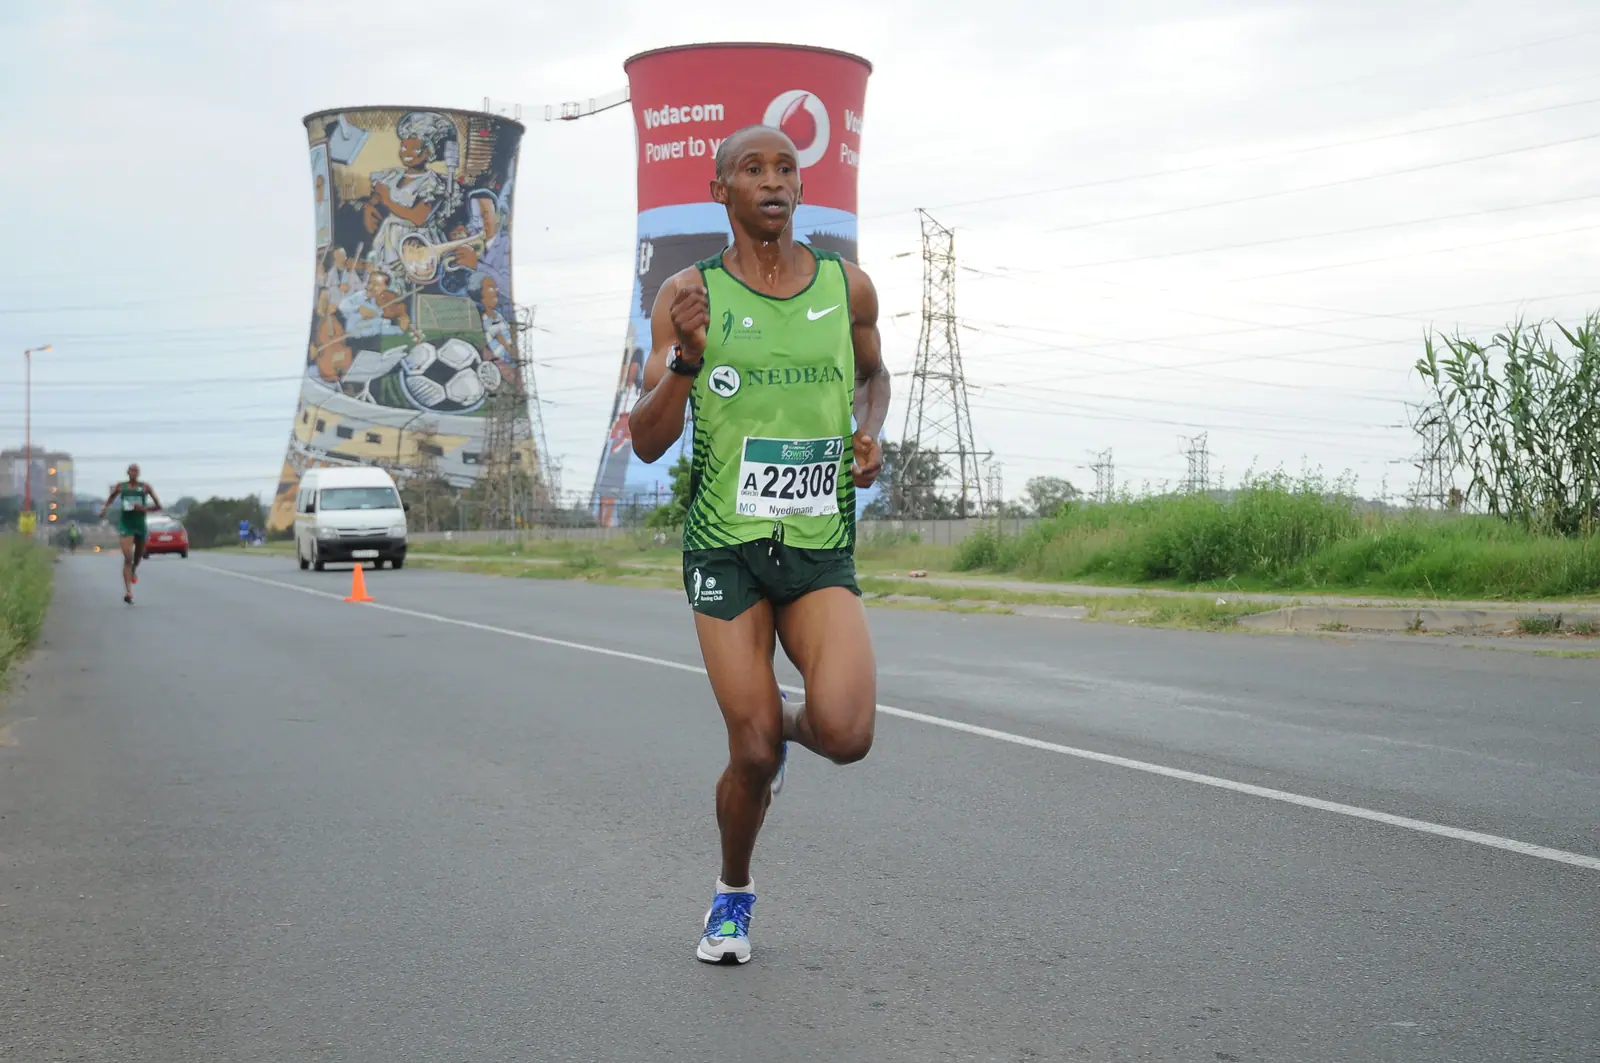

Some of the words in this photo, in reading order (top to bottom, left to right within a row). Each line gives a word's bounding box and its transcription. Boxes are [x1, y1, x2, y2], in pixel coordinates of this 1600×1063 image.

[644, 104, 724, 130] Vodacom
[646, 141, 687, 164] Power
[688, 135, 706, 157] to
[824, 440, 841, 455] 21
[743, 473, 757, 490] A
[760, 463, 837, 499] 22308
[739, 503, 757, 513] MO
[769, 505, 814, 516] Nyedimane
